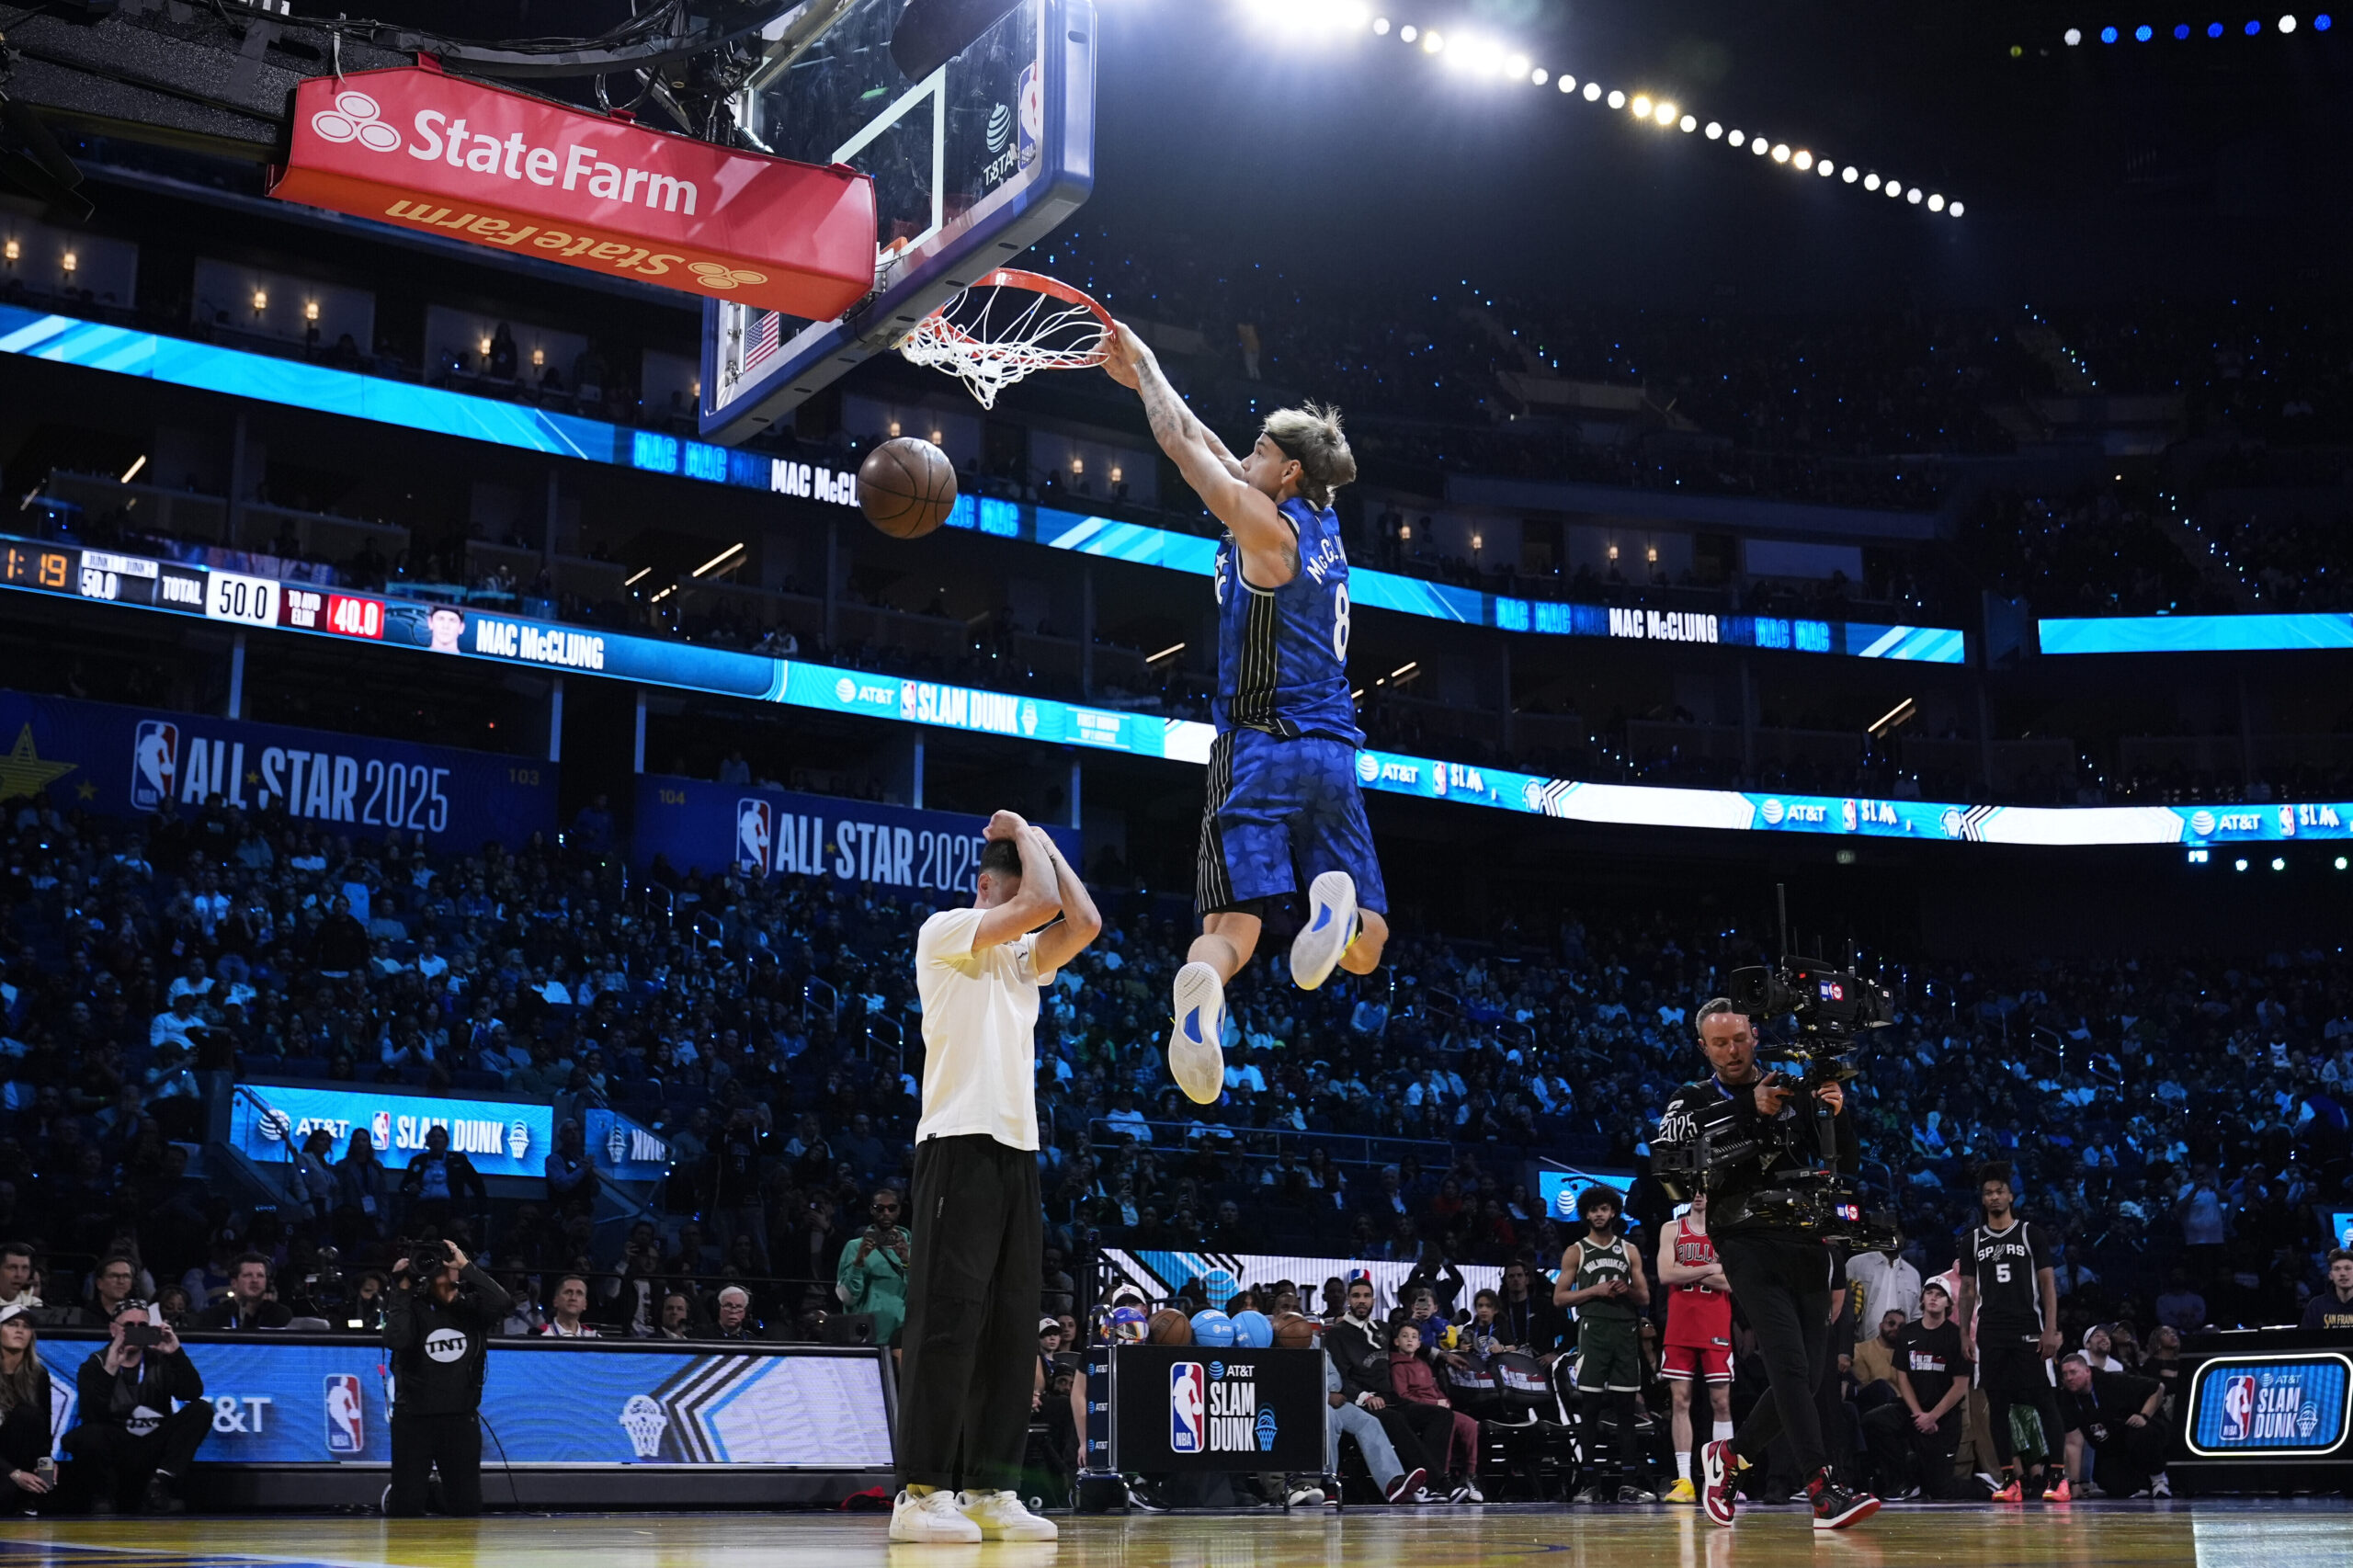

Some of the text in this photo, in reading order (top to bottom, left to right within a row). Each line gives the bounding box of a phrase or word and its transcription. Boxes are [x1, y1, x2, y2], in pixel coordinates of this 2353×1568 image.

[770, 458, 812, 498] MAC
[81, 568, 118, 601] 50.0
[163, 575, 268, 619] TOTAL 50.0
[334, 597, 379, 636] 40.0
[1333, 582, 1350, 662] 8
[1608, 607, 1643, 639] MAC
[1646, 610, 1719, 643] McCLUNG
[476, 619, 604, 669] MAC McCLUNG
[858, 683, 1019, 734] AT&T SLAM DUNK
[182, 736, 450, 834] ALL STAR 2025
[509, 766, 540, 787] 103
[1381, 763, 1419, 784] AT&T
[658, 788, 686, 806] 104
[1787, 804, 1826, 823] AT&T
[2219, 813, 2261, 831] AT&T
[775, 812, 827, 876] ALL
[835, 820, 914, 887] STAR
[295, 1117, 350, 1140] AT&T
[453, 1119, 504, 1154] DUNK
[1583, 1257, 1628, 1274] MILWAUKEE
[1995, 1263, 2011, 1283] 5
[426, 1337, 466, 1354] TNT
[1095, 1364, 1108, 1373] AT&T
[1226, 1365, 1256, 1377] AT&T
[2275, 1374, 2302, 1385] AT&T
[1095, 1403, 1108, 1412] AT&T
[1210, 1381, 1256, 1416] SLAM
[2256, 1386, 2302, 1413] SLAM
[1210, 1416, 1256, 1452] DUNK
[2222, 1425, 2238, 1437] NBA
[2254, 1413, 2298, 1438] DUNK
[1095, 1440, 1108, 1449] AT&T
[1176, 1432, 1192, 1447] NBA
